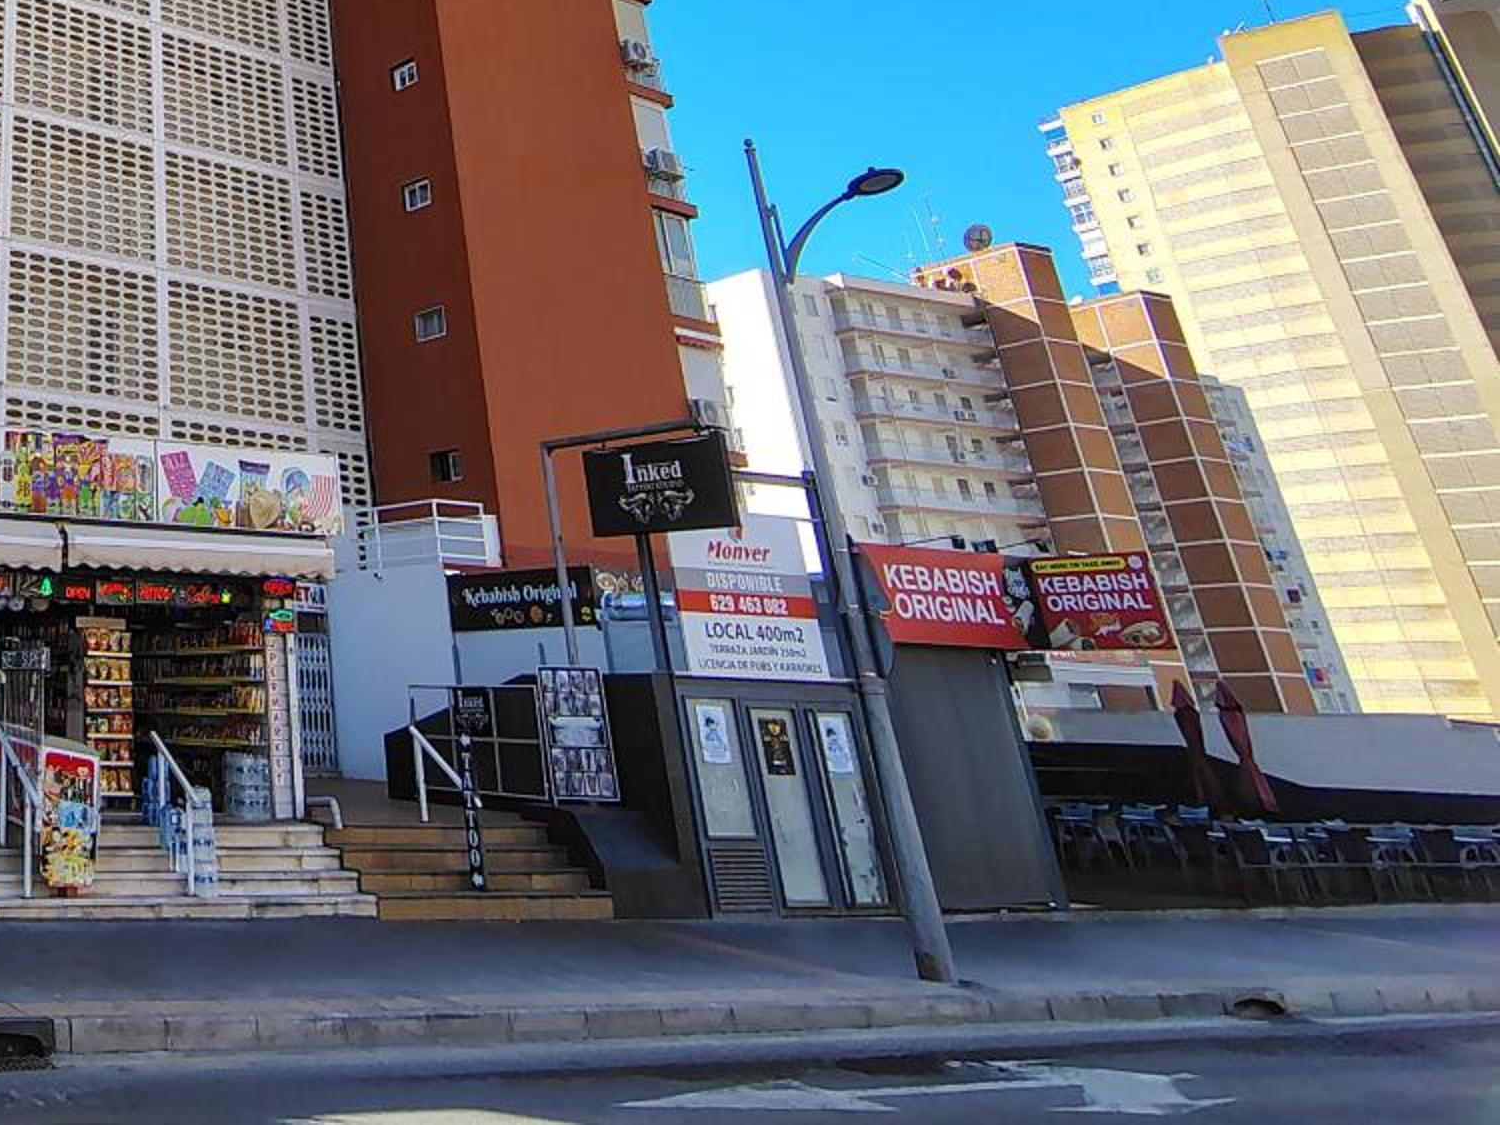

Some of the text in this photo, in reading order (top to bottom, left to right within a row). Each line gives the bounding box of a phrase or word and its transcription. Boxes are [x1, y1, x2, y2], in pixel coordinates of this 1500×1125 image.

[620, 453, 683, 484] Inked
[707, 540, 771, 563] Monver
[706, 572, 784, 593] DISPONIBLE
[883, 564, 1001, 596] KEBABISH
[1039, 573, 1149, 594] KEBABISH
[462, 584, 521, 607] Kebabish
[1047, 592, 1153, 613] ORIGINAL
[895, 593, 1006, 625] ORIGINAL
[705, 622, 805, 644] LOCAL 400m2
[461, 752, 481, 867] TATTOO
